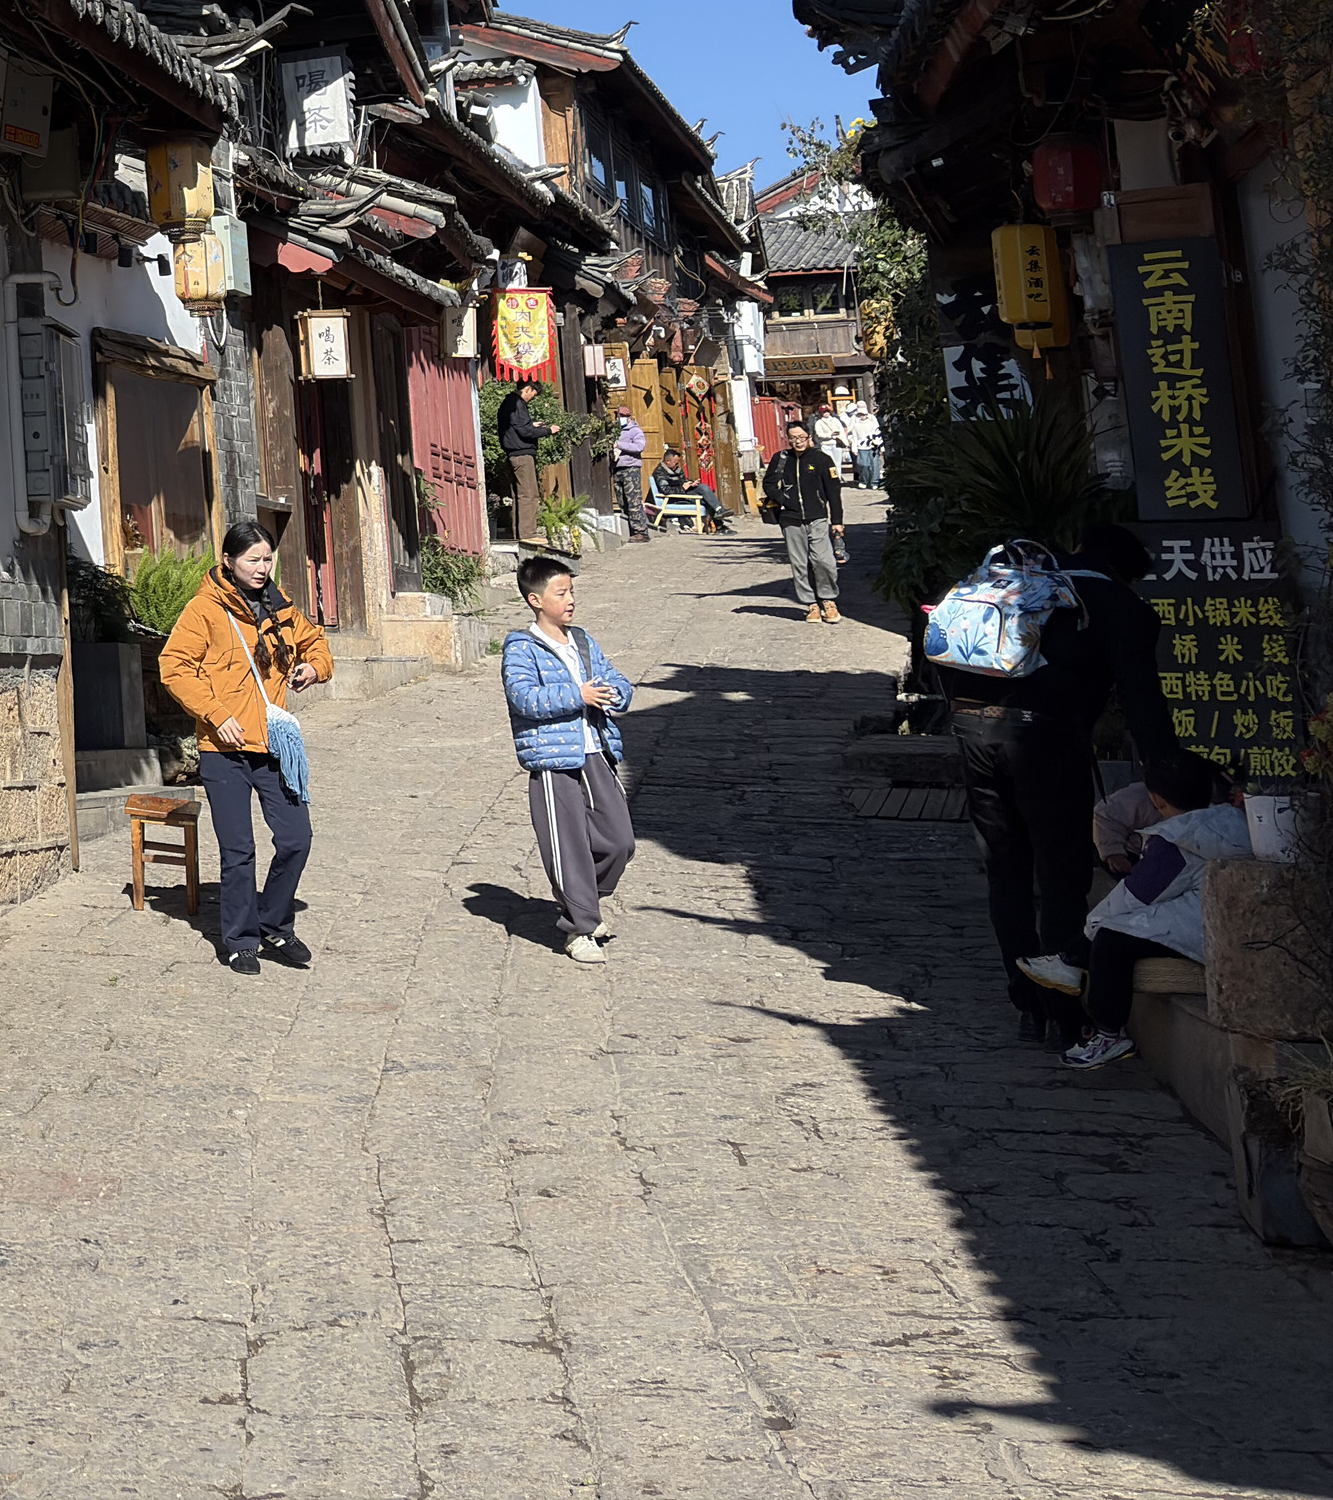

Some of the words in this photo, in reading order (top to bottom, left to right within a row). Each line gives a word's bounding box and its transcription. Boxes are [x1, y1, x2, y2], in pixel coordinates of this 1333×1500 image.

[295, 69, 335, 134] 喝茶
[1025, 245, 1048, 303] 云集酒吧
[317, 325, 340, 366] 喝茶
[512, 309, 535, 357] 肉夹馍
[1137, 249, 1219, 510] 云南过桥米线
[1142, 535, 1280, 582] 天供应
[1141, 596, 1290, 628] 西小锅米线
